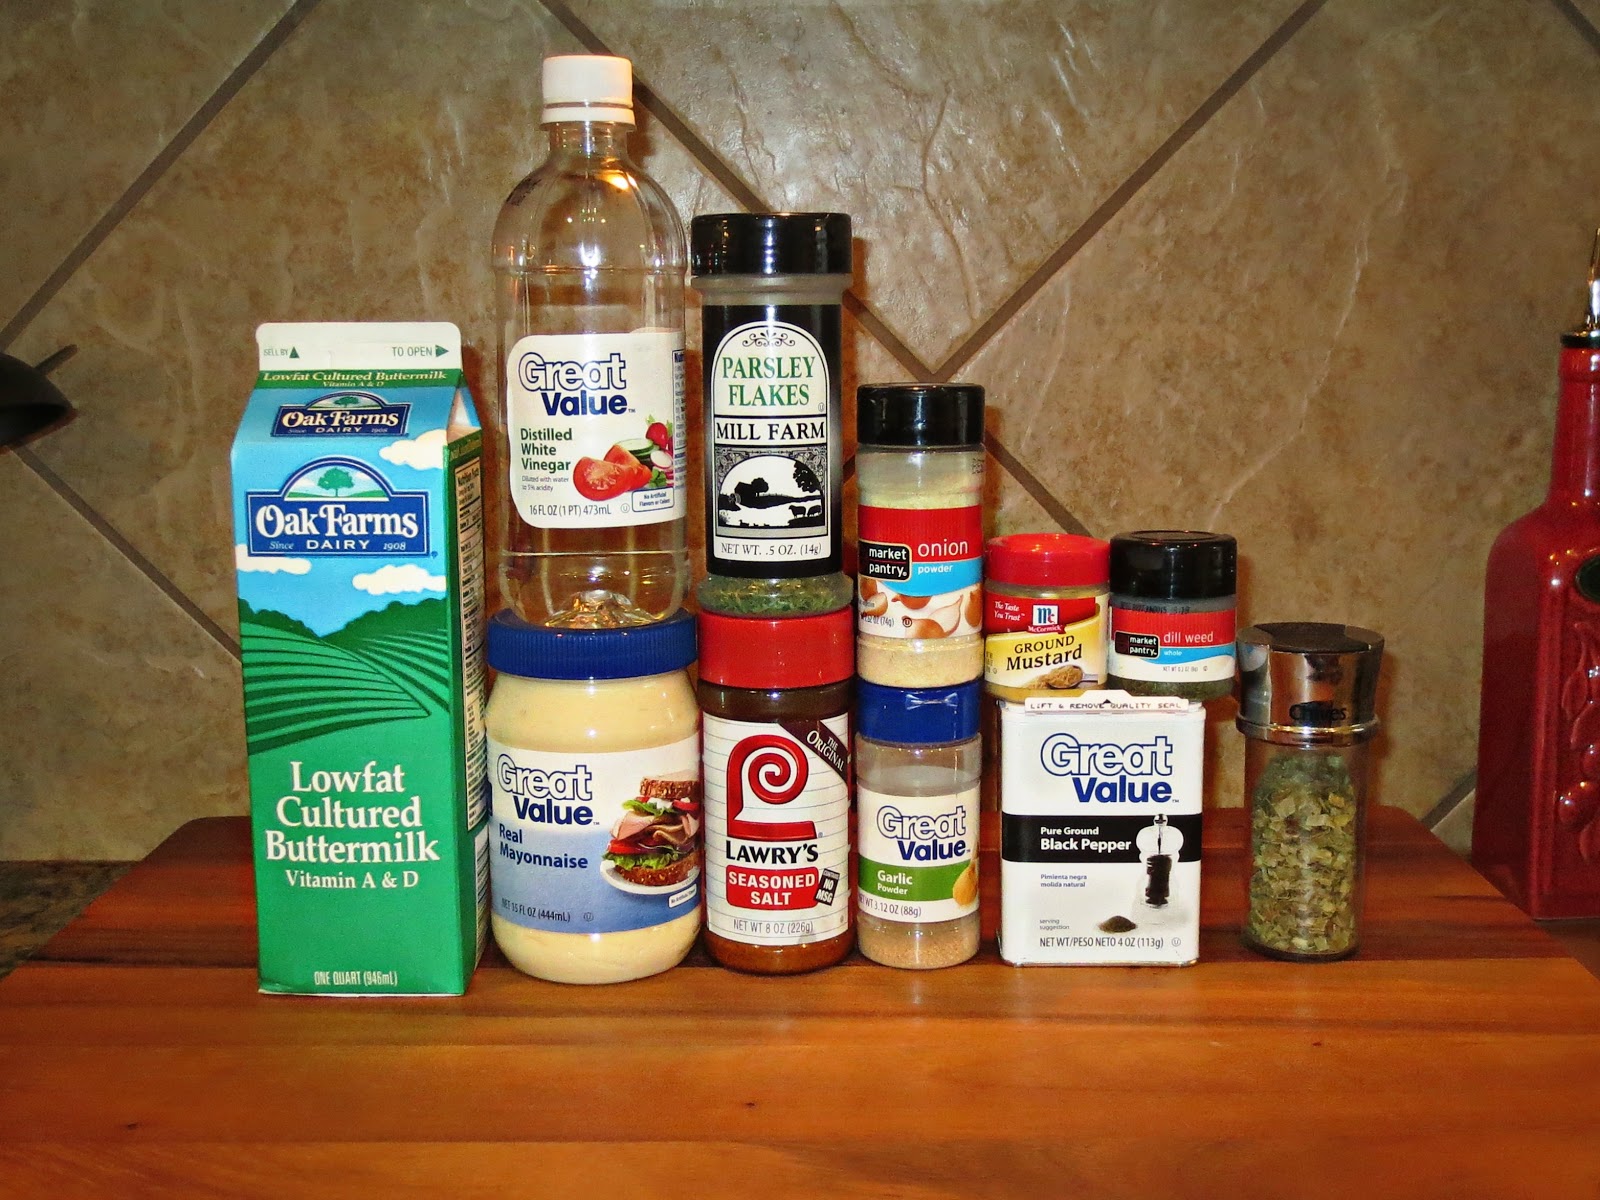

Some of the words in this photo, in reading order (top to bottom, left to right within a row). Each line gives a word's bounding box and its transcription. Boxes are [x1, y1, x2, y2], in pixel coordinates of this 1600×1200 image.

[392, 347, 404, 357] TO
[408, 346, 432, 357] OPEN
[518, 352, 626, 392] Great
[722, 356, 816, 378] PARSLEY
[263, 372, 310, 381] Lowfat
[312, 372, 372, 381] Cultured
[375, 371, 446, 380] Buttermilk
[541, 390, 628, 416] Value
[728, 384, 810, 406] FLAKES
[282, 412, 327, 427] Oak
[329, 411, 399, 427] Farms
[520, 428, 572, 441] Distilled
[716, 422, 760, 440] MILL
[768, 422, 824, 440] FARM
[521, 443, 556, 456] White
[522, 458, 571, 473] Vinegar
[530, 505, 538, 516] 16
[538, 505, 546, 516] FL
[548, 505, 558, 516] OZ
[569, 505, 582, 517] PT)
[583, 504, 612, 516] 473mL
[256, 504, 318, 538] Oak
[319, 504, 418, 538] Farms
[270, 541, 294, 550] Since
[306, 540, 370, 550] DAIRY
[384, 542, 406, 550] 1908
[722, 542, 740, 554] NET
[742, 544, 762, 555] WT.
[766, 546, 774, 556] .5
[778, 544, 796, 556] OZ.
[800, 542, 822, 556] (14g)
[918, 538, 968, 556] onion
[869, 548, 906, 560] market
[918, 564, 953, 575] powder
[1004, 602, 1020, 612] Taste
[1014, 635, 1074, 654] GROUND
[1130, 636, 1156, 645] market
[1164, 632, 1181, 643] dill
[1185, 632, 1214, 643] weed
[1006, 644, 1082, 670] Mustard
[806, 730, 844, 772] ORIGINAL
[827, 736, 838, 750] THE
[1040, 732, 1174, 776] Great
[290, 761, 405, 792] Lowfat
[496, 754, 592, 800] Great
[1072, 775, 1172, 804] Value
[276, 796, 422, 828] Cultured
[512, 796, 594, 825] Value
[877, 805, 966, 840] Great
[500, 823, 523, 844] Real
[1040, 826, 1062, 836] Pure
[1064, 826, 1099, 836] Ground
[266, 830, 440, 863] Buttermilk
[726, 840, 818, 864] LAWRY'S
[897, 839, 966, 861] Value
[1040, 838, 1078, 850] Black
[1081, 839, 1132, 853] Pepper
[500, 841, 588, 869] Mayonnaise
[286, 870, 356, 888] Vitamin
[362, 872, 376, 888] A
[382, 872, 398, 888] &
[403, 870, 419, 887] D
[728, 872, 816, 888] SEASONED
[823, 878, 834, 890] NO
[878, 870, 912, 885] Garlic
[816, 889, 834, 904] MSG
[878, 882, 908, 895] Powder
[750, 892, 792, 906] SALT
[501, 898, 510, 910] NET
[519, 905, 526, 916] FL
[528, 906, 536, 918] OZ
[538, 908, 570, 922] (444mL)
[874, 900, 888, 912] 3.12
[890, 904, 898, 914] OZ
[900, 905, 922, 918] (88g)
[734, 919, 748, 932] NET
[750, 921, 762, 934] WT
[766, 922, 771, 934] 8
[774, 922, 784, 934] OZ
[787, 921, 814, 934] (226g)
[1040, 936, 1054, 947] NET
[1056, 936, 1094, 948] WT/PESO
[1095, 936, 1116, 947] NETO
[1118, 937, 1124, 946] 4
[1124, 937, 1136, 946] OZ
[1137, 937, 1164, 949] (113g)
[314, 971, 330, 985] ONE
[333, 971, 361, 985] QUART
[364, 971, 398, 987] (946mL)
